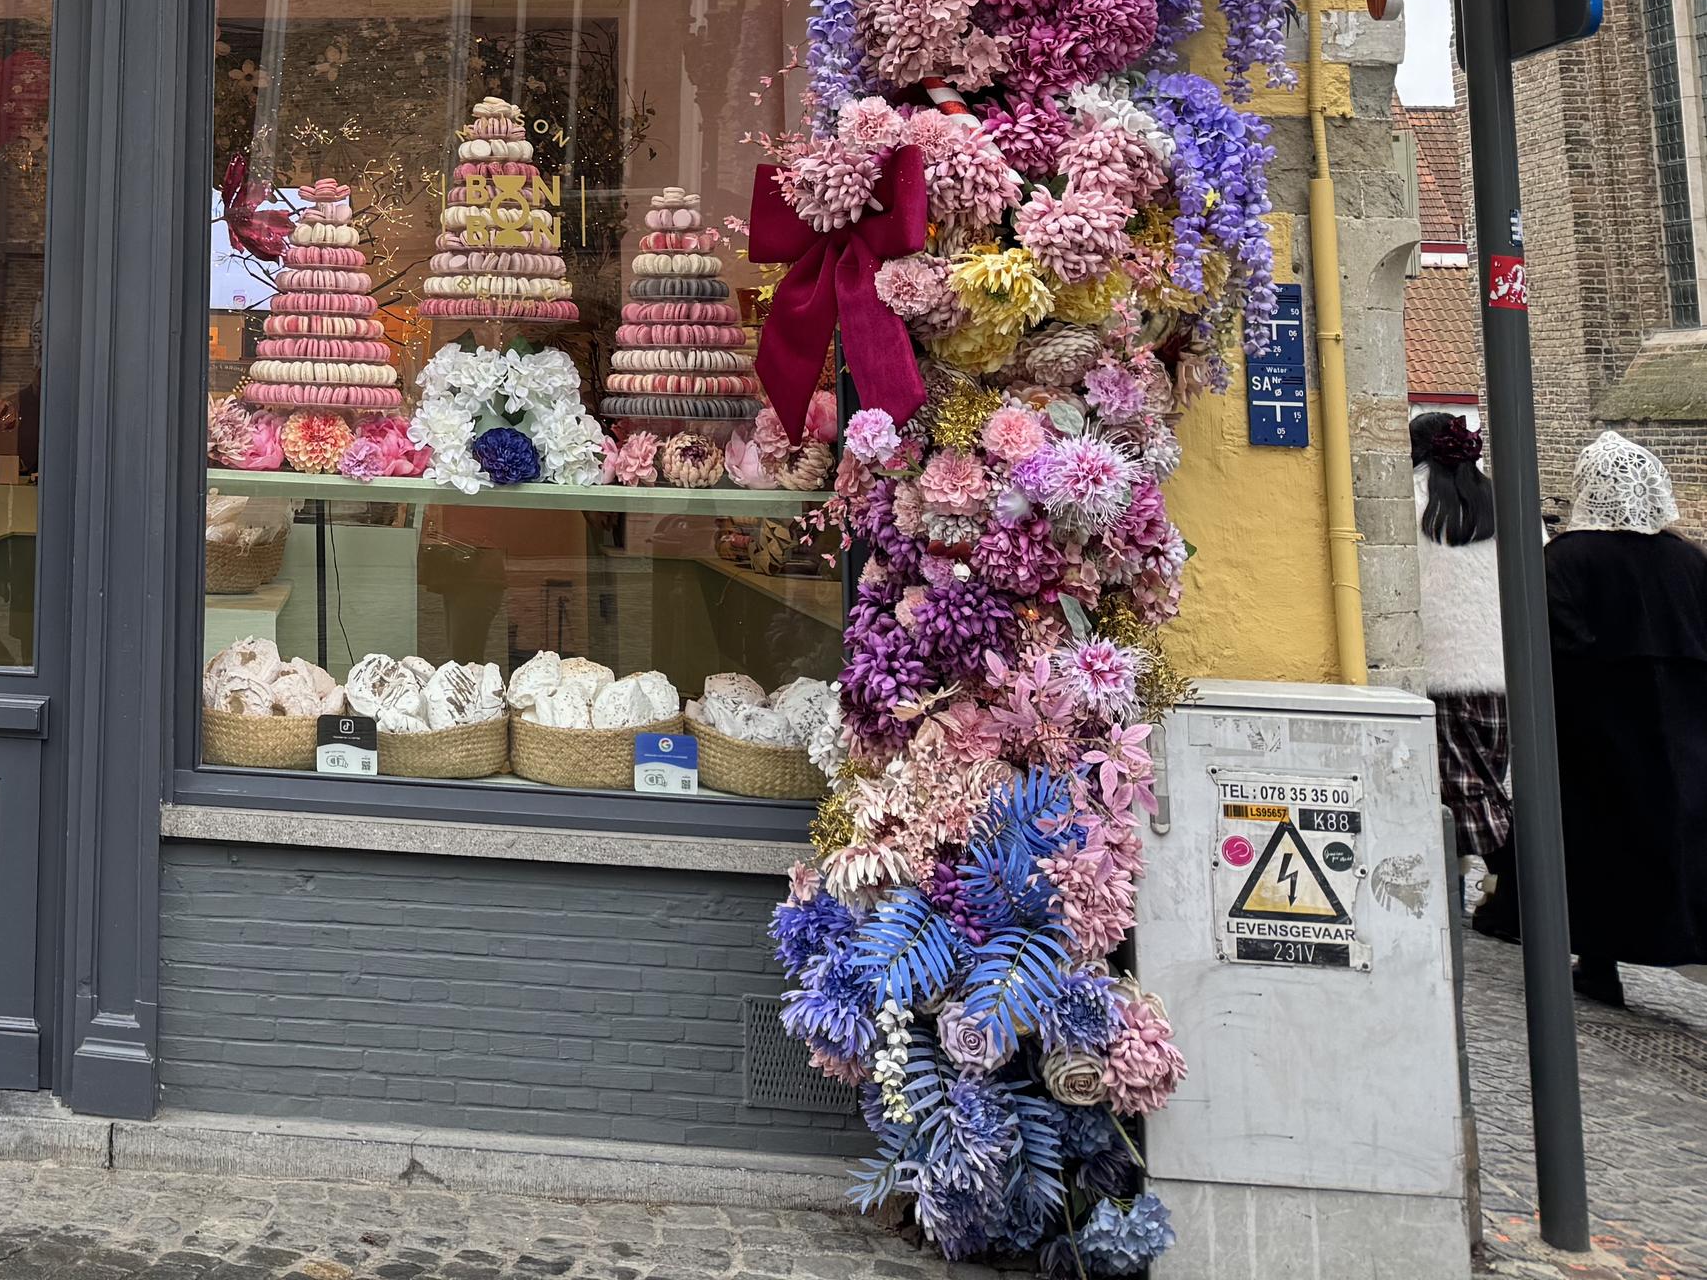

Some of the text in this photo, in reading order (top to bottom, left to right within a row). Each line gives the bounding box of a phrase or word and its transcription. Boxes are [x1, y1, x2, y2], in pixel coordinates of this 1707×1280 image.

[1251, 376, 1282, 391] SA Nr
[1293, 411, 1302, 419] 15
[1276, 427, 1286, 435] 05
[1260, 785, 1286, 801] 078
[1290, 787, 1307, 802] 35
[1311, 788, 1328, 803] 35
[1332, 789, 1349, 804] 00
[1250, 807, 1287, 818] LS95657
[1314, 811, 1350, 832] K88
[1226, 921, 1356, 941] LEVENSGEVAAR
[1273, 941, 1315, 962] 231V
